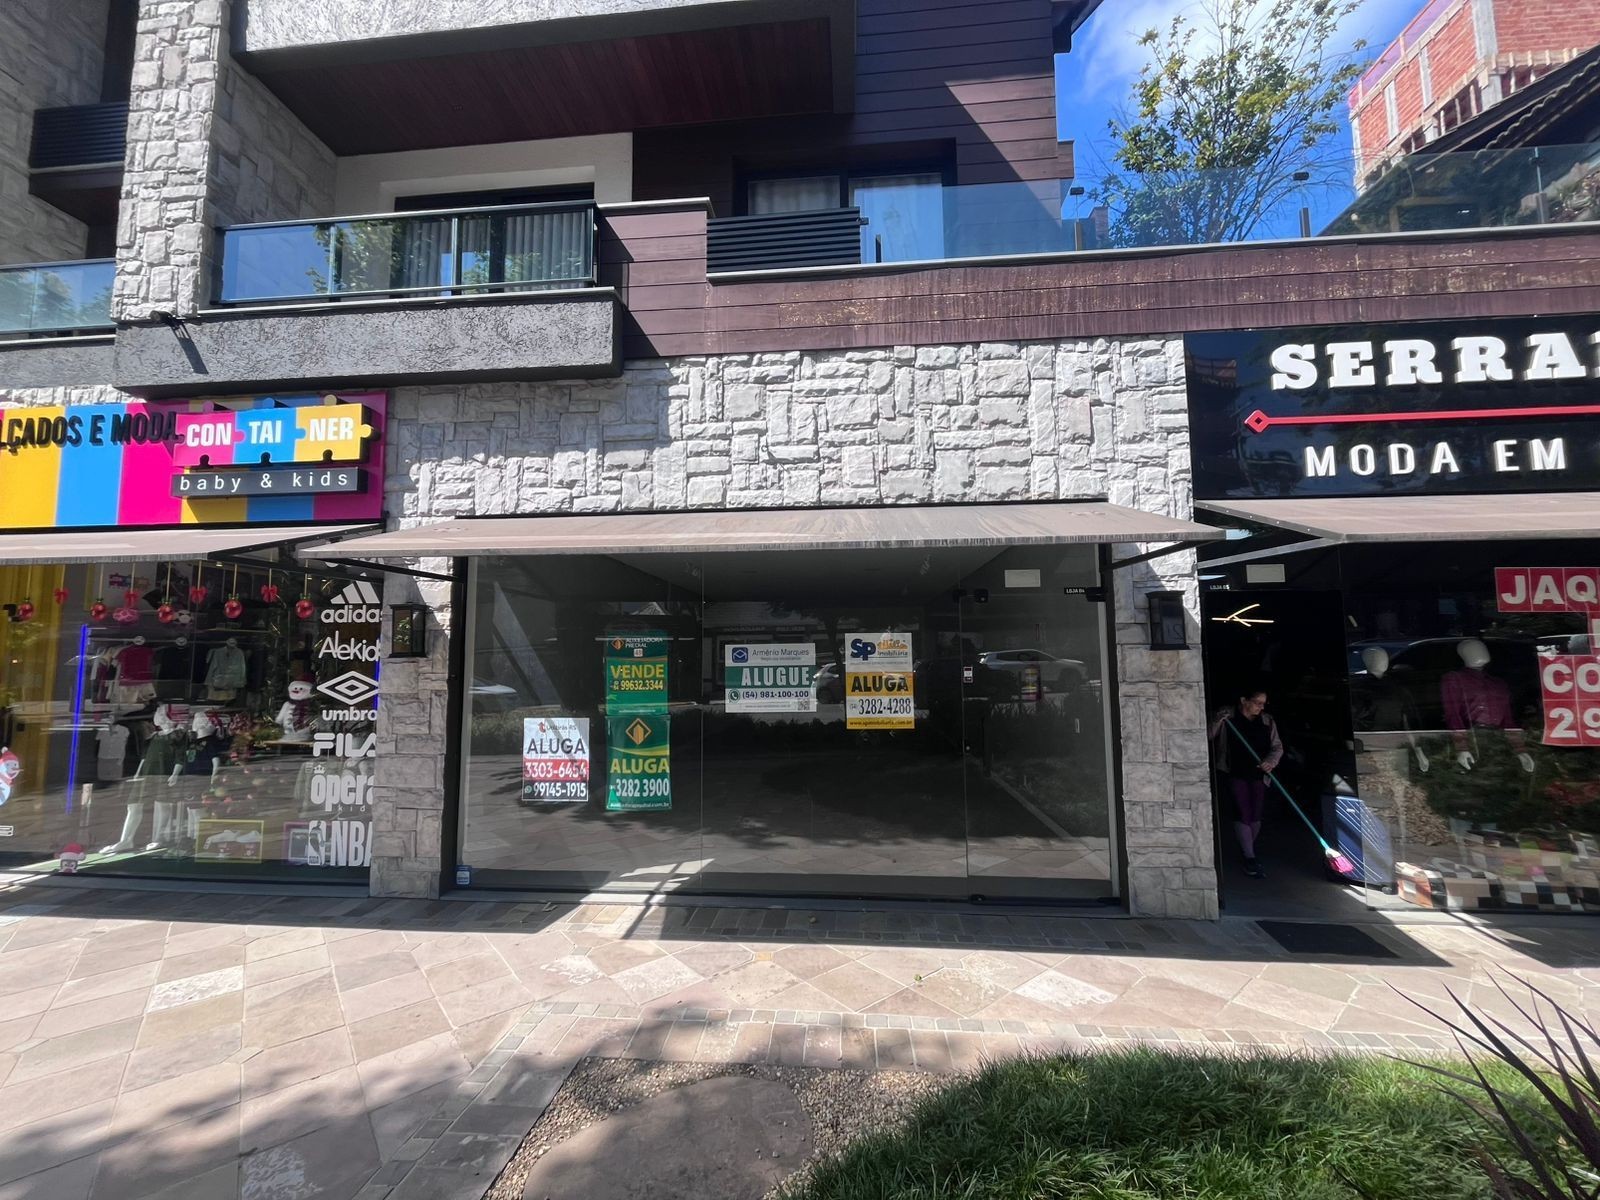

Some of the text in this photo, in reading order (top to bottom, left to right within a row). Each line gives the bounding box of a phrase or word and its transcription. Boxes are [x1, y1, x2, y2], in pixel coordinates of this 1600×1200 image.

[1269, 331, 1600, 391] SERRA
[89, 414, 106, 446] E
[110, 410, 179, 446] MODA
[186, 416, 354, 447] CON TAI NER
[1304, 438, 1567, 477] MODA EM
[179, 471, 348, 493] baby & kids
[318, 630, 381, 662] Alekid
[780, 649, 810, 657] Marques
[610, 664, 665, 679] VENDE
[741, 667, 810, 687] ALUGUE
[851, 675, 909, 693] ALUGA
[742, 691, 758, 700] (54)
[526, 738, 586, 754] ALUGA
[524, 761, 588, 778] 3303-6454
[610, 758, 670, 774] ALUGA
[533, 782, 587, 798] 99145-1915
[616, 778, 670, 797] 3282 3900
